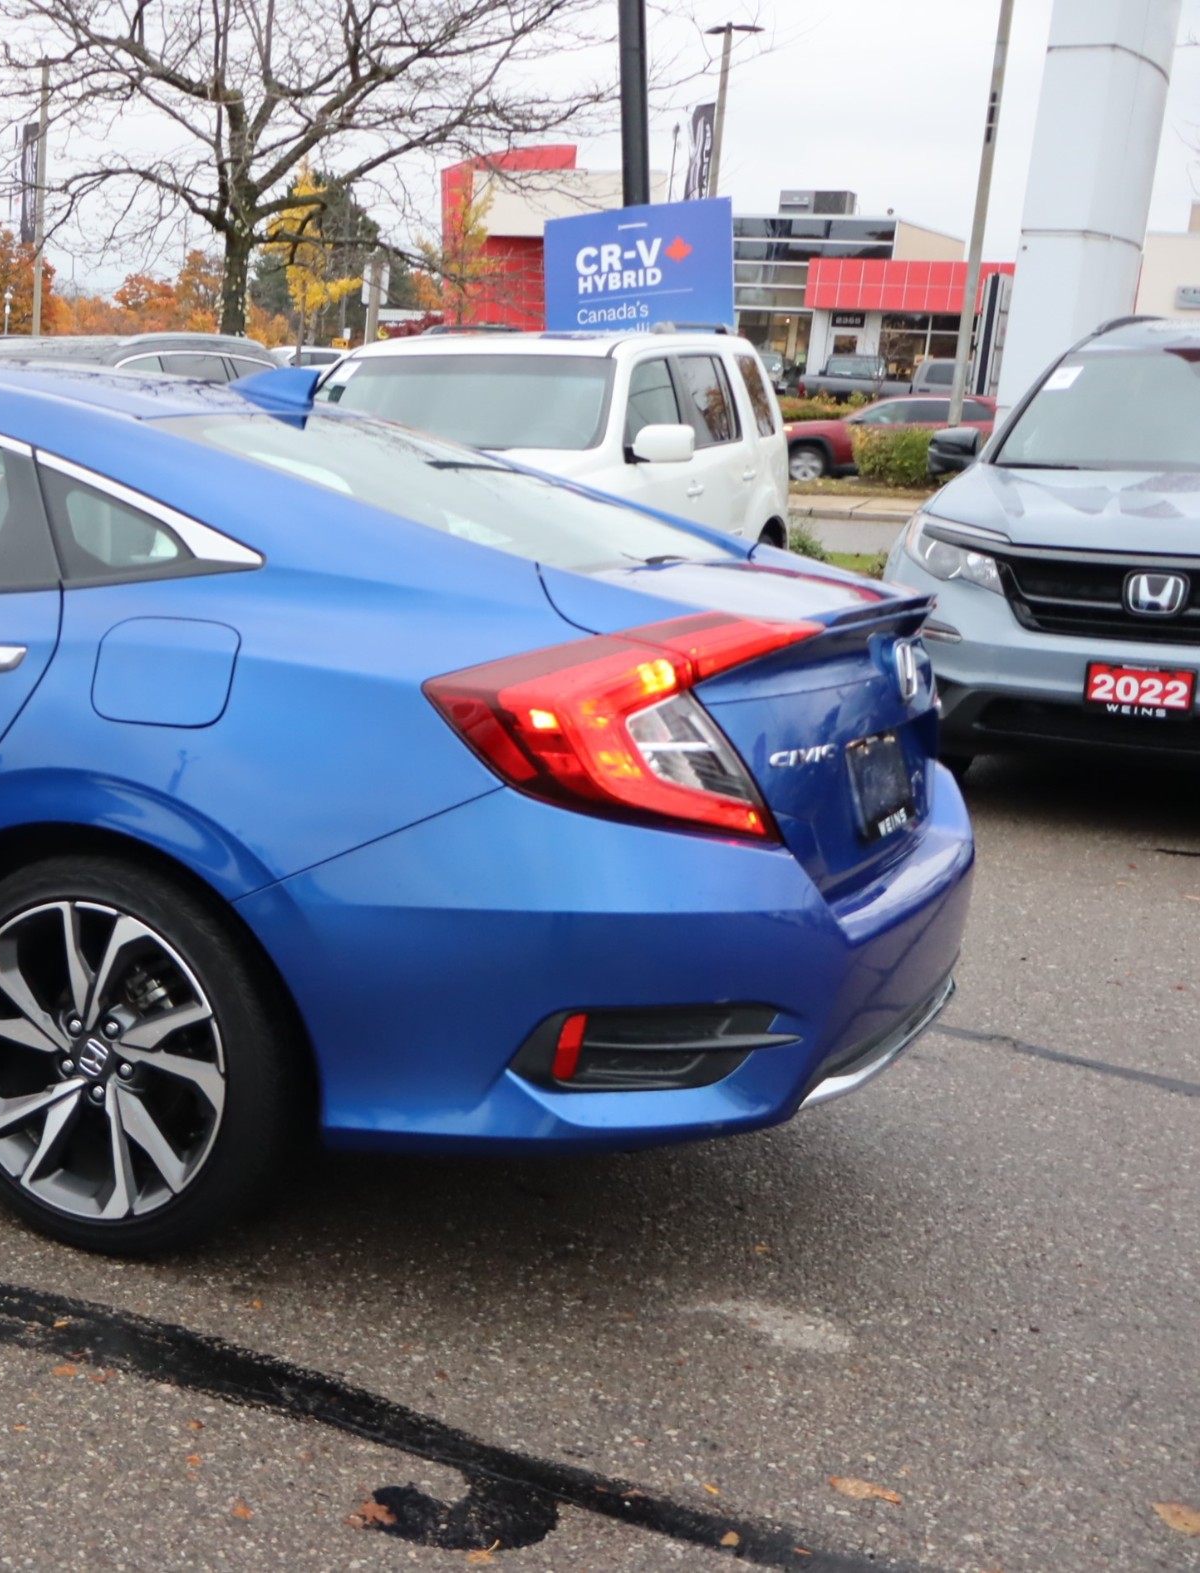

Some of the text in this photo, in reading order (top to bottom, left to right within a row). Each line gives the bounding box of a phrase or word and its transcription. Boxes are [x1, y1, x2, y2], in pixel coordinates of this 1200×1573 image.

[576, 238, 662, 275] CR-V
[578, 268, 662, 294] HYBRID
[577, 301, 649, 325] Canada's
[1091, 673, 1188, 707] 2022
[1106, 703, 1166, 718] WEINS
[769, 744, 836, 767] CIVIC
[877, 807, 908, 838] WEINS
